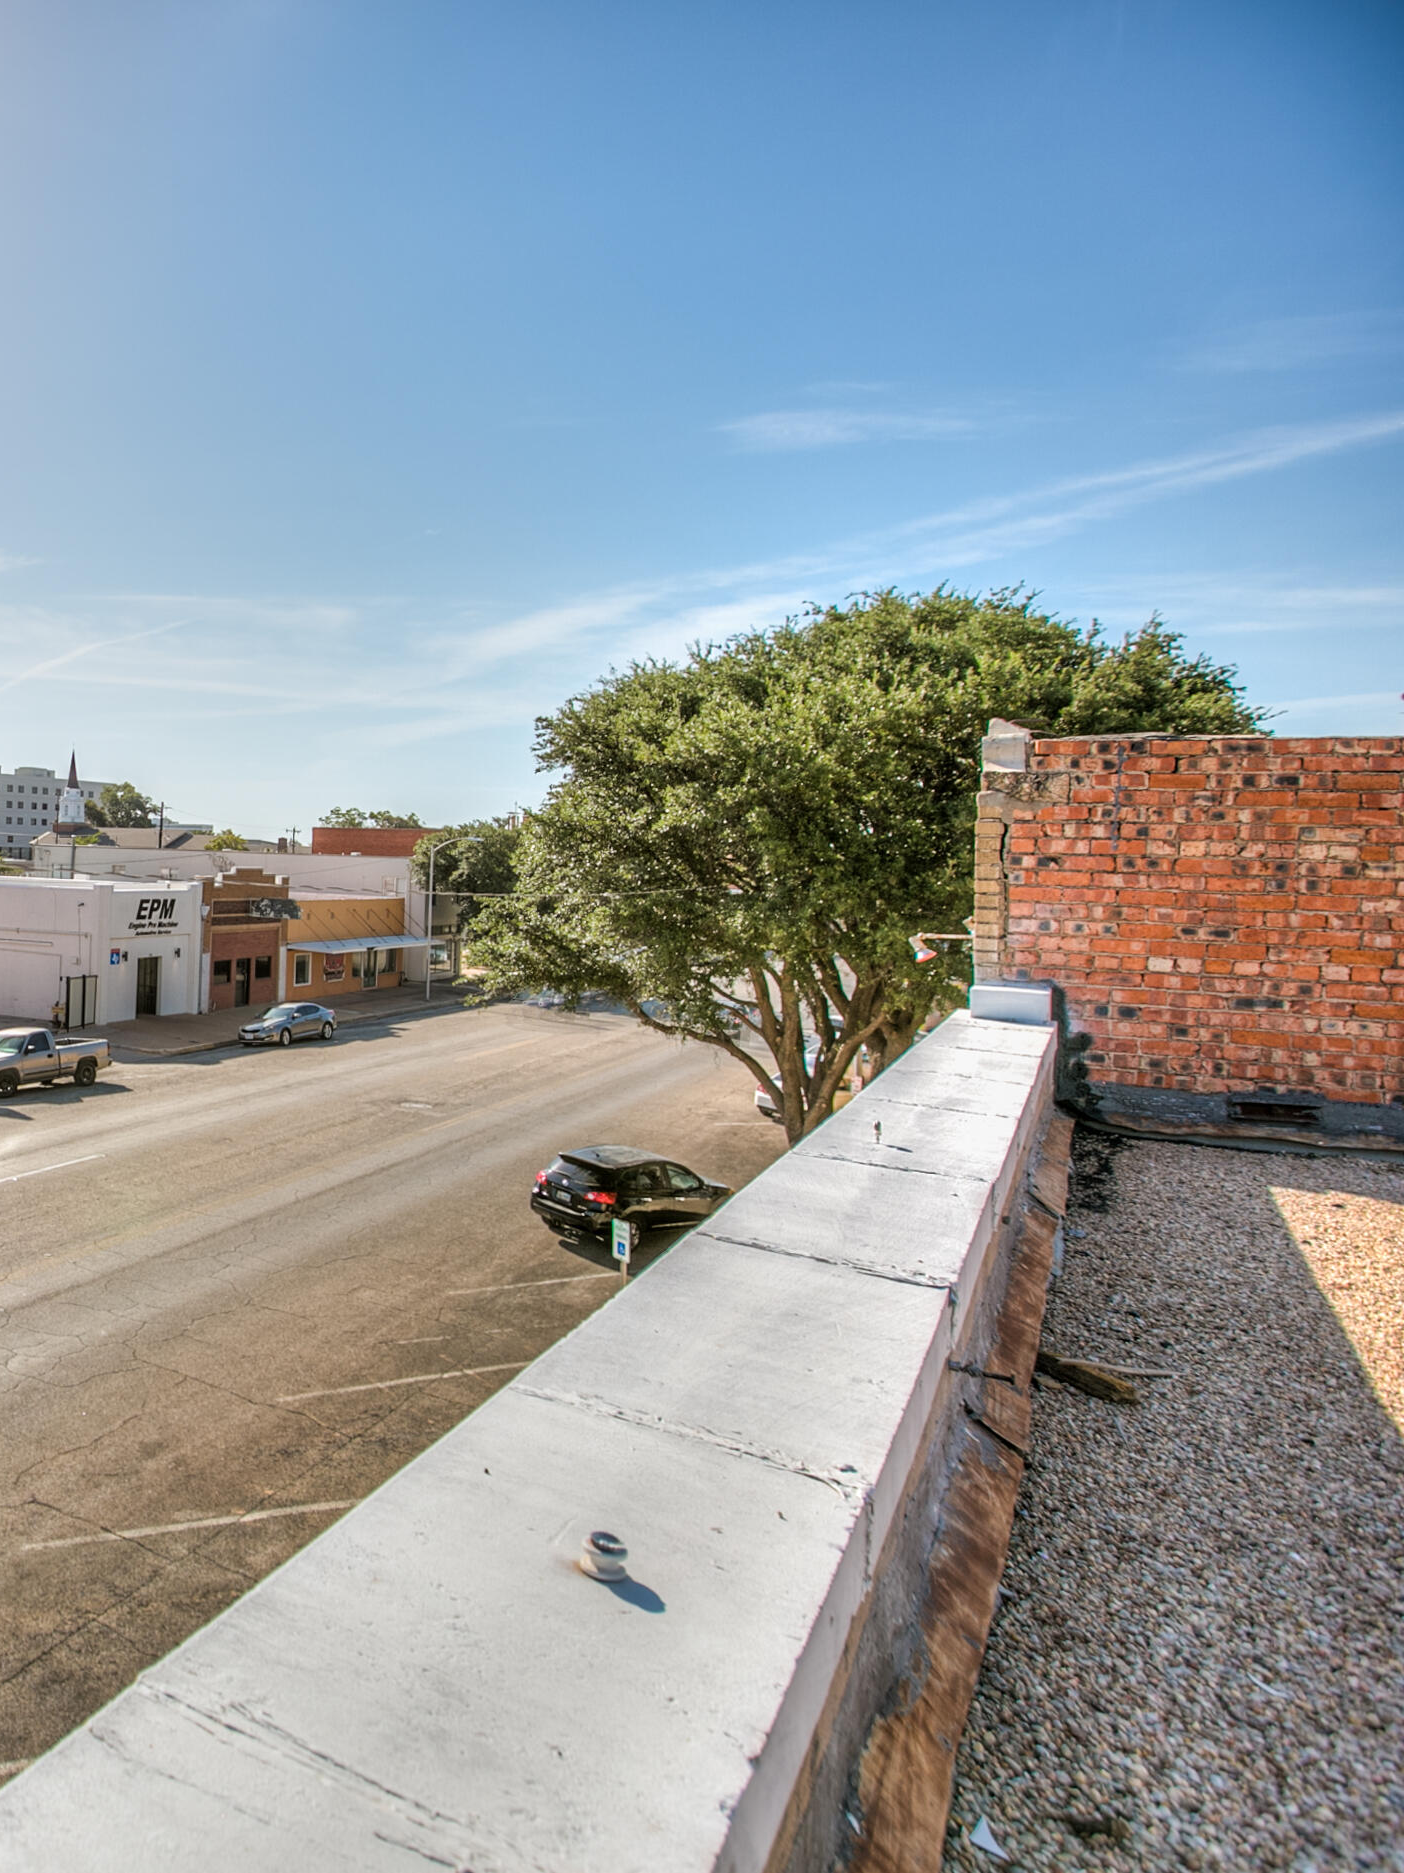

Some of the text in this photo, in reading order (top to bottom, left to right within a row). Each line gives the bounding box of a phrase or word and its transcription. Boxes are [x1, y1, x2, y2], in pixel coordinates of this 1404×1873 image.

[136, 898, 176, 920] EPM
[128, 922, 147, 930] Engine
[157, 920, 179, 928] Machine
